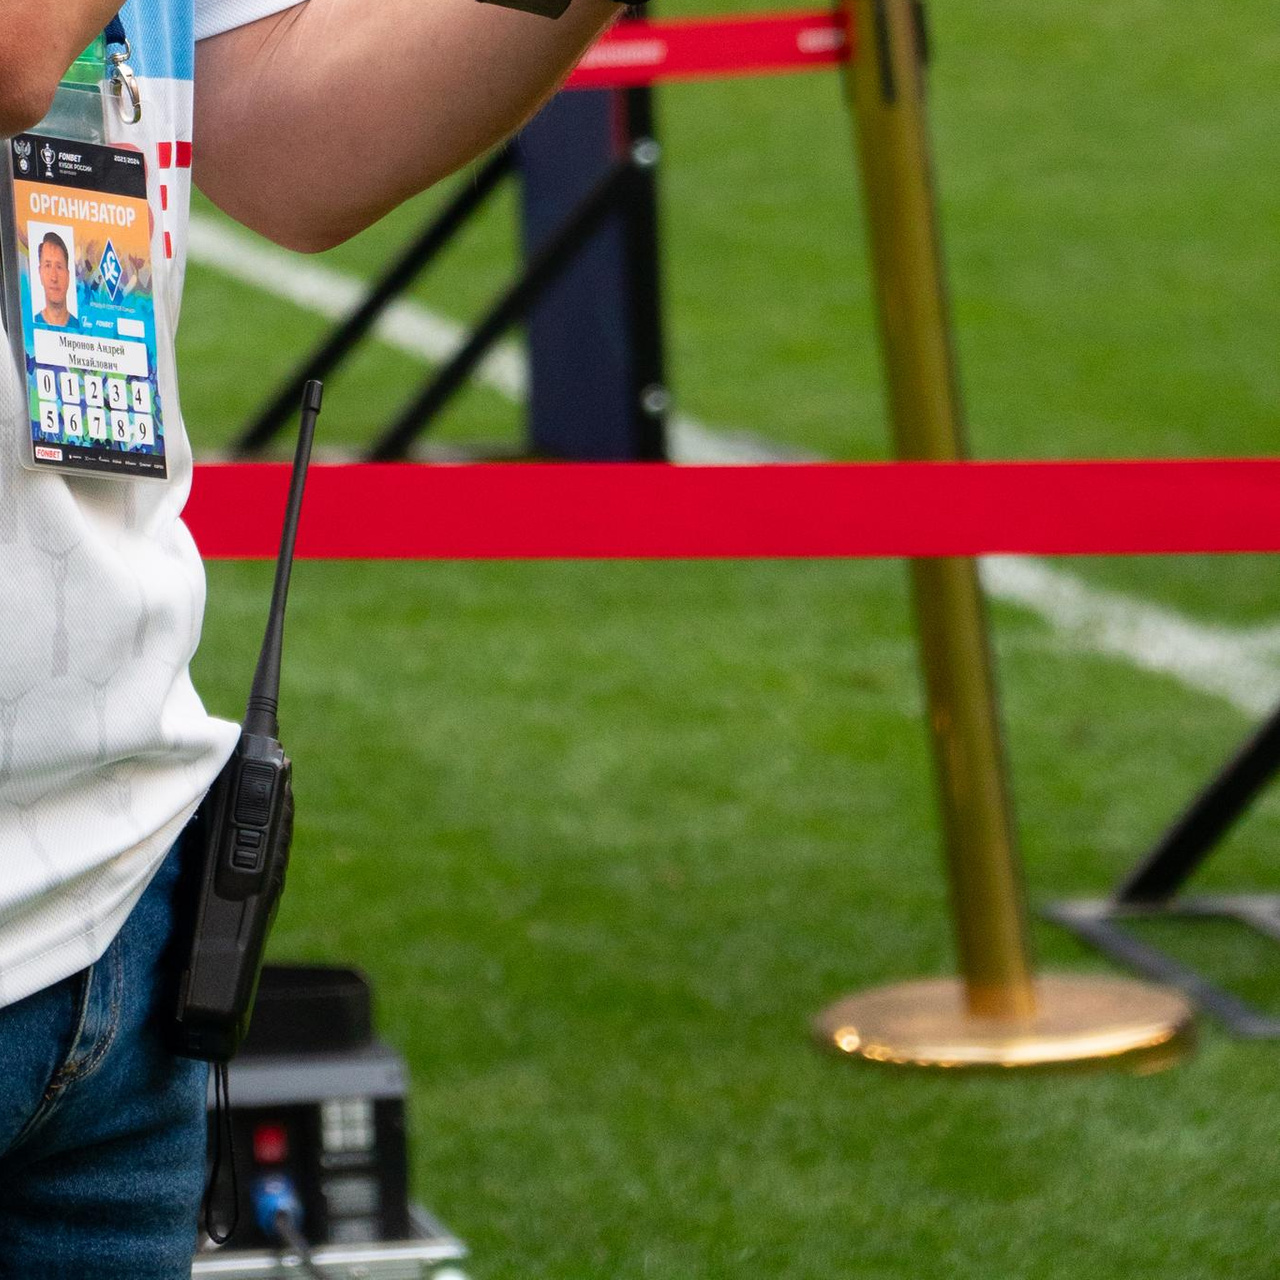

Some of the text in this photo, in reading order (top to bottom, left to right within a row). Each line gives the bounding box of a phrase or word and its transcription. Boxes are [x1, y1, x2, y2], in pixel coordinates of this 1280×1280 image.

[58, 152, 83, 163] FONBET
[29, 192, 136, 228] ОРГАНИЗАТОР
[59, 335, 125, 356] Миронов Андрей
[68, 354, 118, 371] Михайлович
[43, 375, 142, 407] 0 1 2 3 4
[46, 410, 147, 440] 5 6 7 8 9
[37, 448, 61, 459] FONBET
